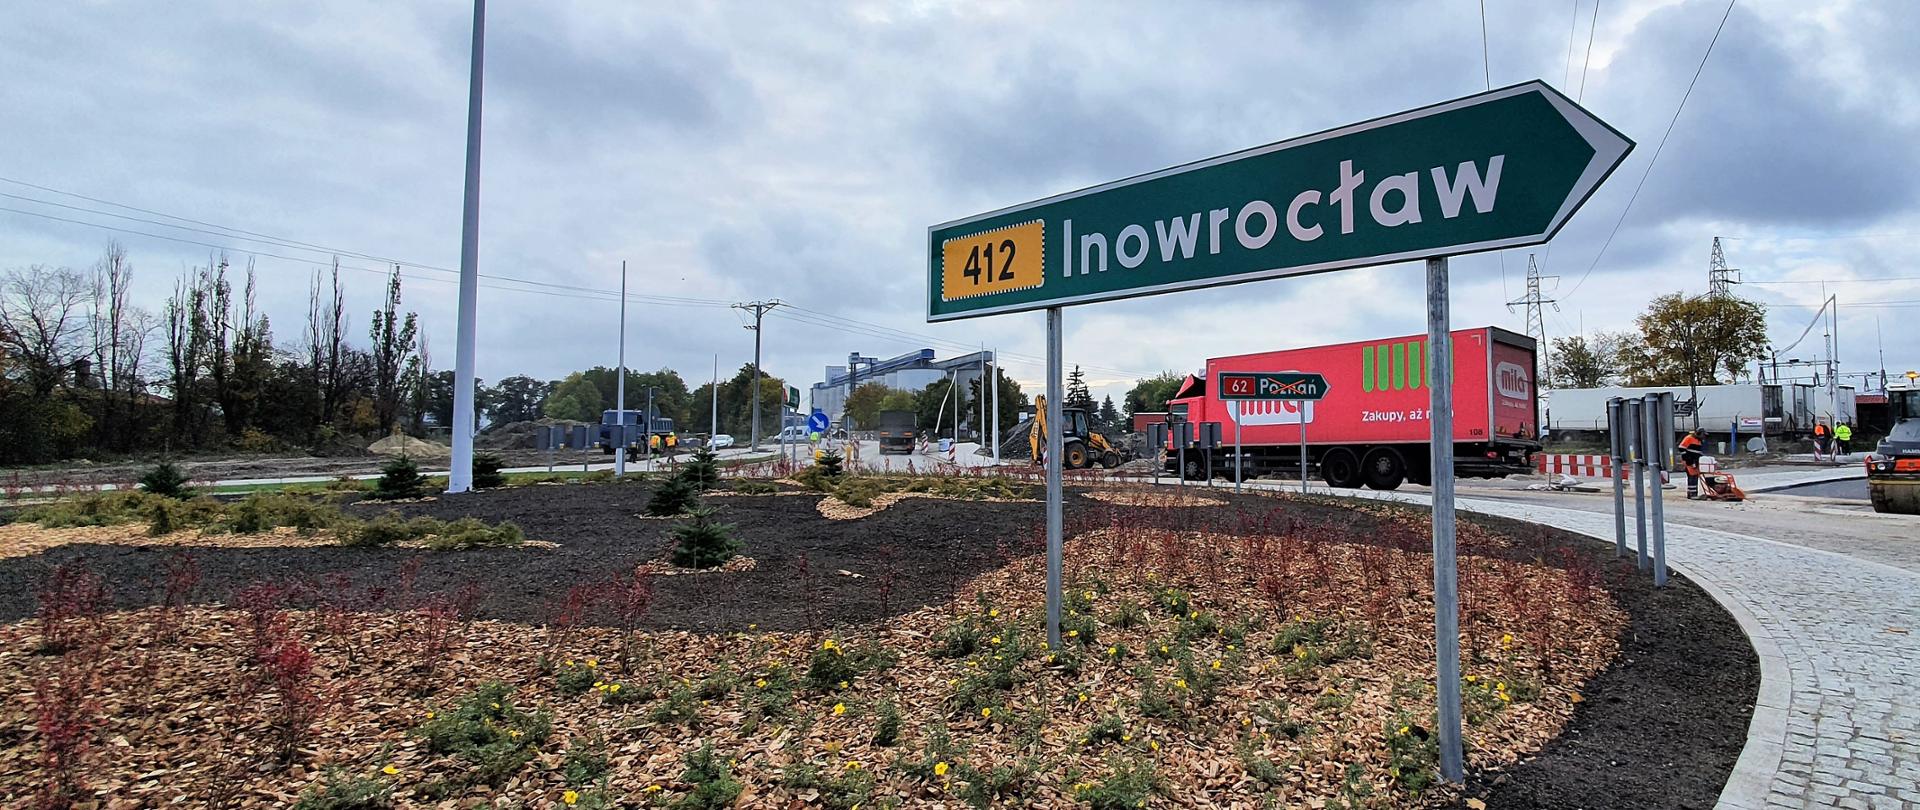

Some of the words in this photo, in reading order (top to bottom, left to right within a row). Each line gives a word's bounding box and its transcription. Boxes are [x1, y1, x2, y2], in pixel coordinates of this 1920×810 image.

[963, 239, 1016, 285] 412
[1063, 154, 1505, 277] Inowrocław
[1232, 379, 1247, 392] 62
[1260, 378, 1317, 395] Poznań
[1361, 409, 1407, 422] Zakupy,
[1409, 408, 1423, 420] aż
